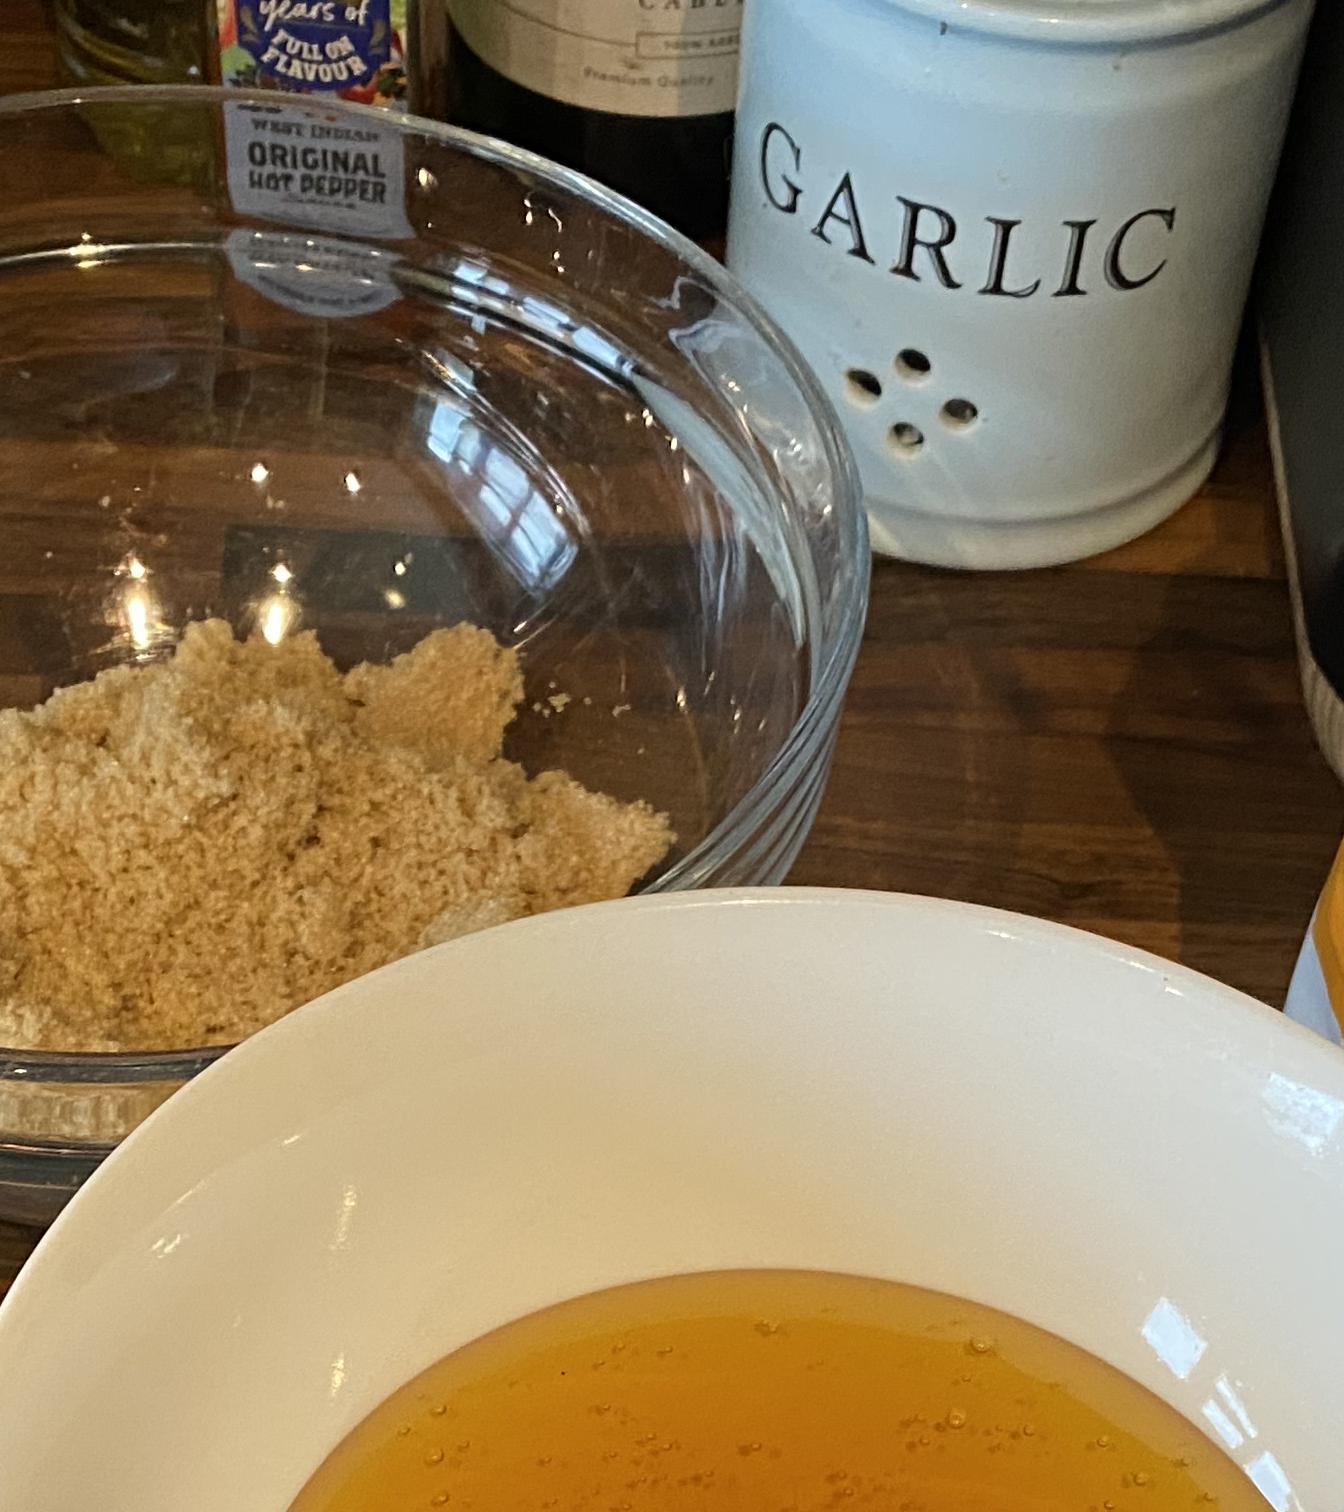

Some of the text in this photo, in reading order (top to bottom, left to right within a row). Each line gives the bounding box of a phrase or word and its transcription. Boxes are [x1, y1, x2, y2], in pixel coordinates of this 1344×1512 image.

[272, 28, 356, 61] FULL ON
[260, 46, 368, 83] FLAVOUR
[248, 140, 387, 179] ORIGINAL
[248, 170, 294, 191] HOT
[300, 173, 387, 205] PEPPER
[759, 121, 1177, 298] GARLIC
